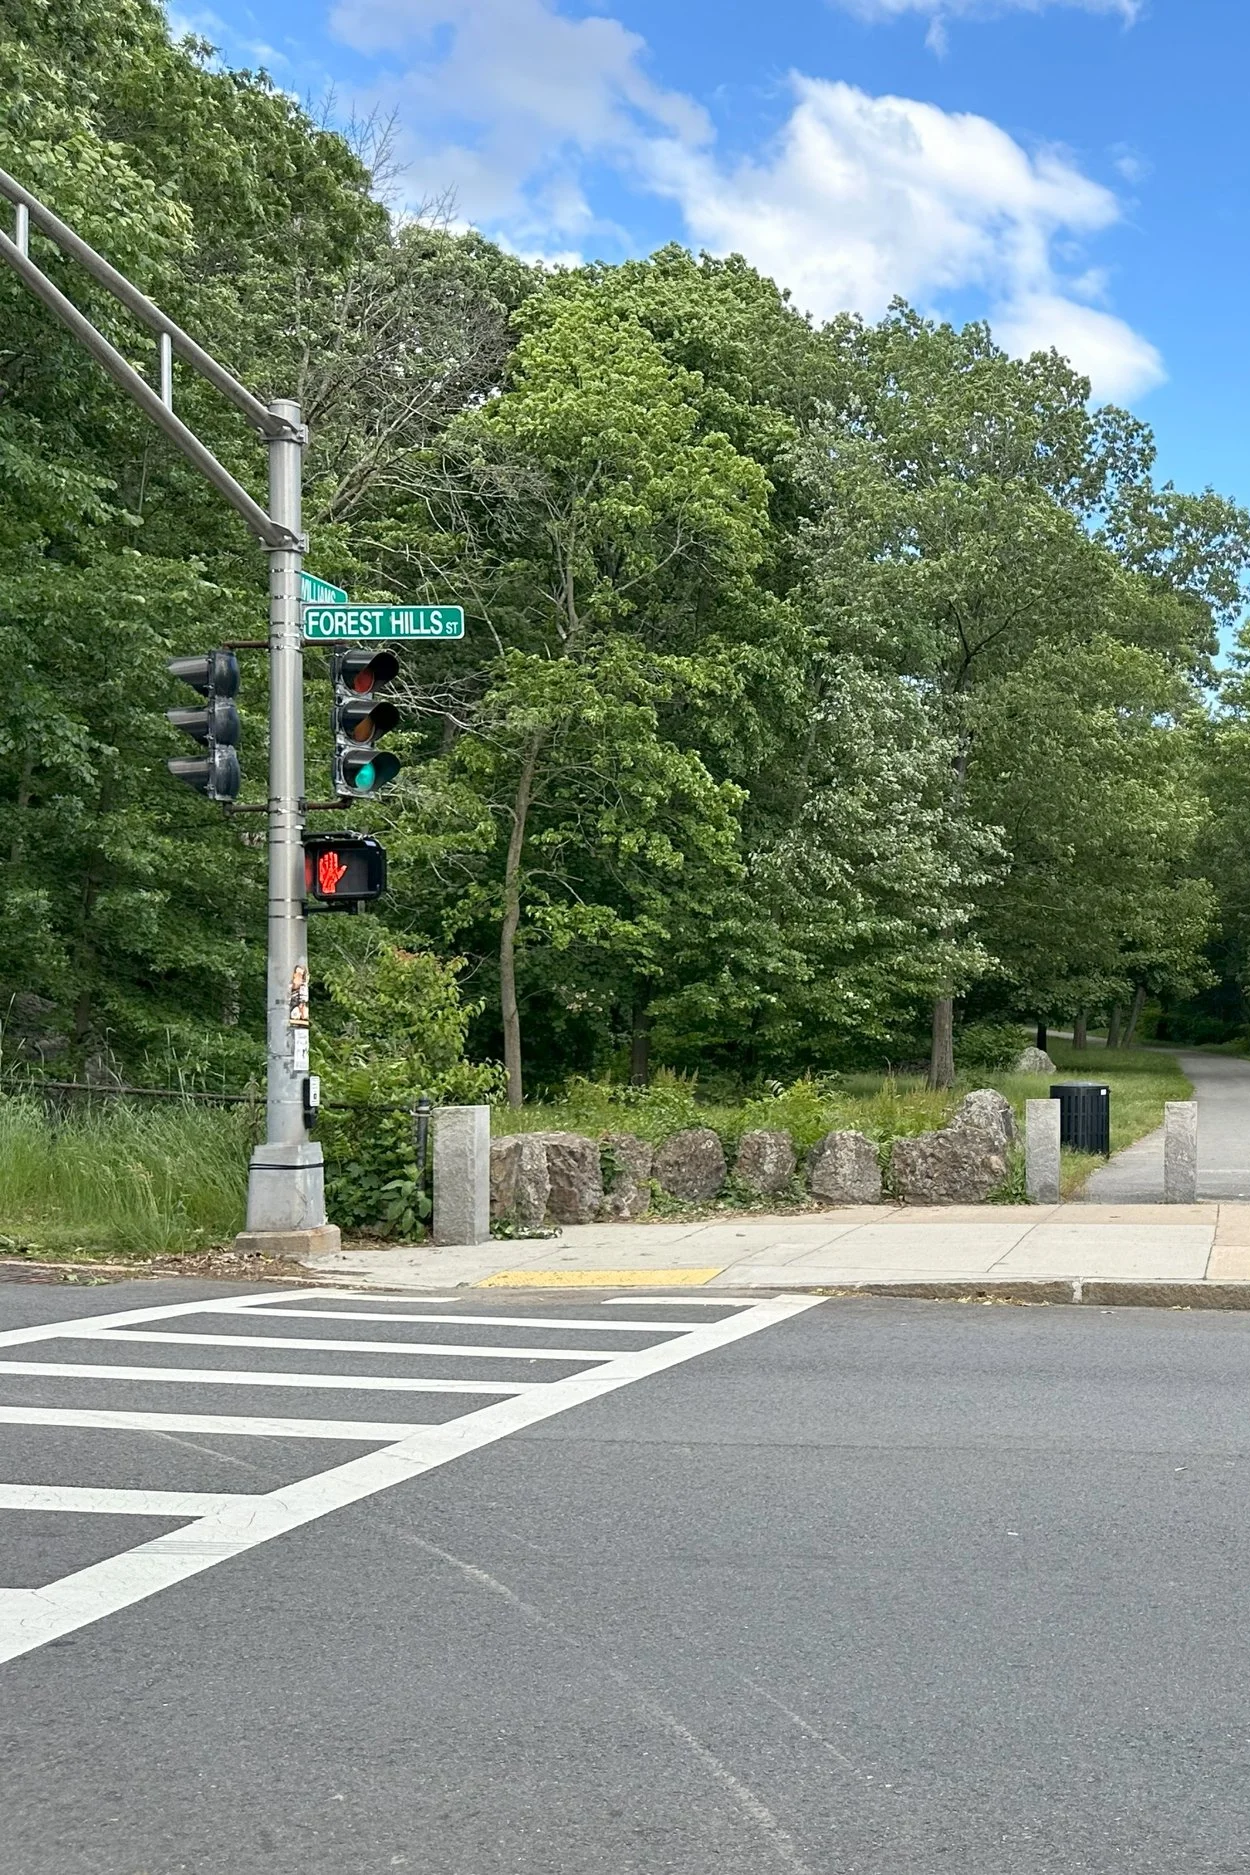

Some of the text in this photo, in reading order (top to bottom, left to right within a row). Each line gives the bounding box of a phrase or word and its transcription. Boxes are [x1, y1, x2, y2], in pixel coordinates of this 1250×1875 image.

[308, 611, 458, 635] FOREST HILLS ST
